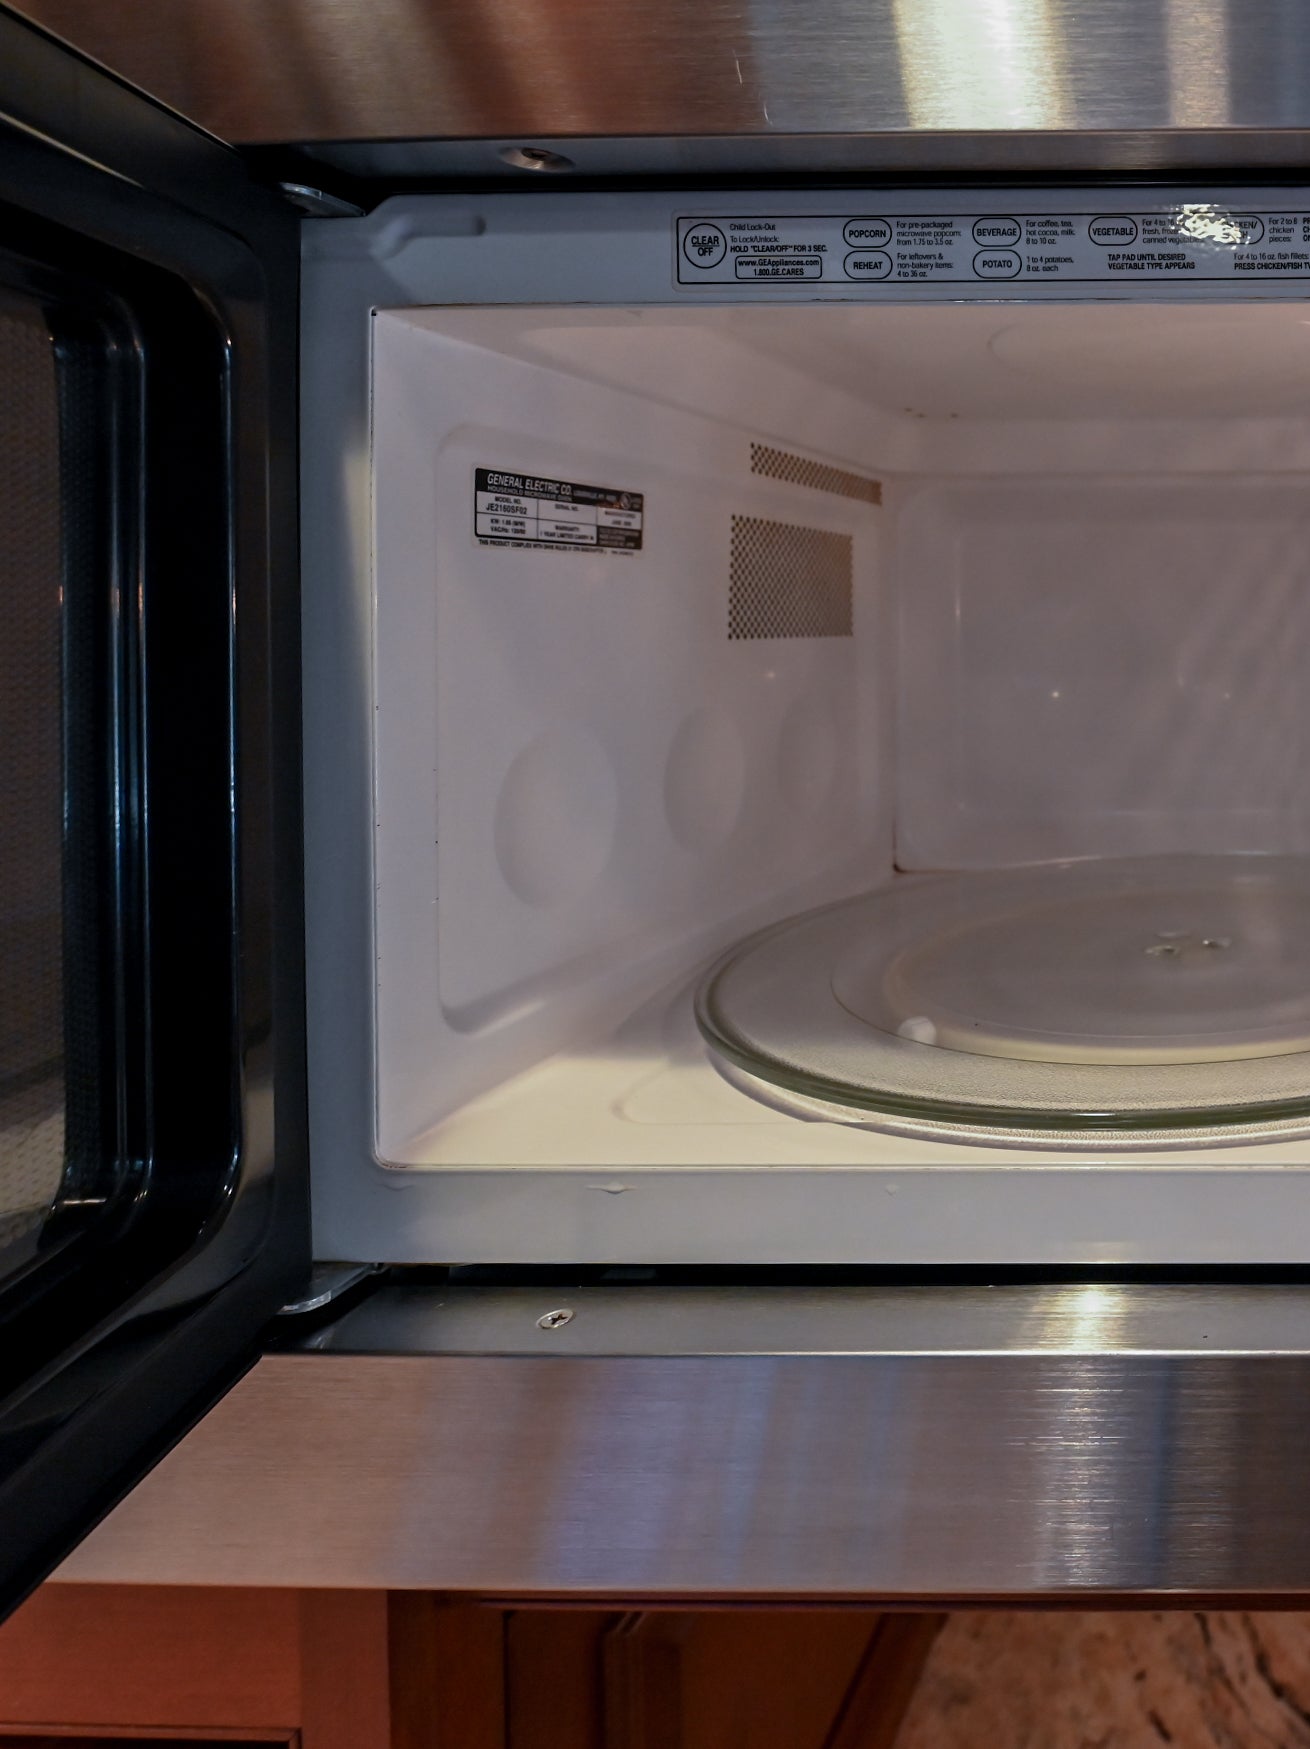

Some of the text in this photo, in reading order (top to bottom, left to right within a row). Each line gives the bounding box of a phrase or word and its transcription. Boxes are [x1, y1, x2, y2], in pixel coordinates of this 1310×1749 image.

[909, 221, 952, 230] pre-packaged
[849, 230, 886, 238] POPCORN
[977, 228, 1016, 236] BEVERAGE
[1092, 228, 1133, 236] VEGETABLE
[692, 236, 719, 245] CLEAR
[698, 248, 713, 256] OFF
[853, 261, 882, 270] REHEAT
[897, 262, 933, 270] non-bakery
[982, 260, 1012, 268] POTATO
[1108, 262, 1144, 270] VEGETABLE
[1257, 262, 1302, 270] CHICKEN/FISH
[754, 268, 804, 276] 1.800.GE.CARES
[488, 473, 524, 489] GENERAL
[525, 480, 560, 493] ELECTRIC
